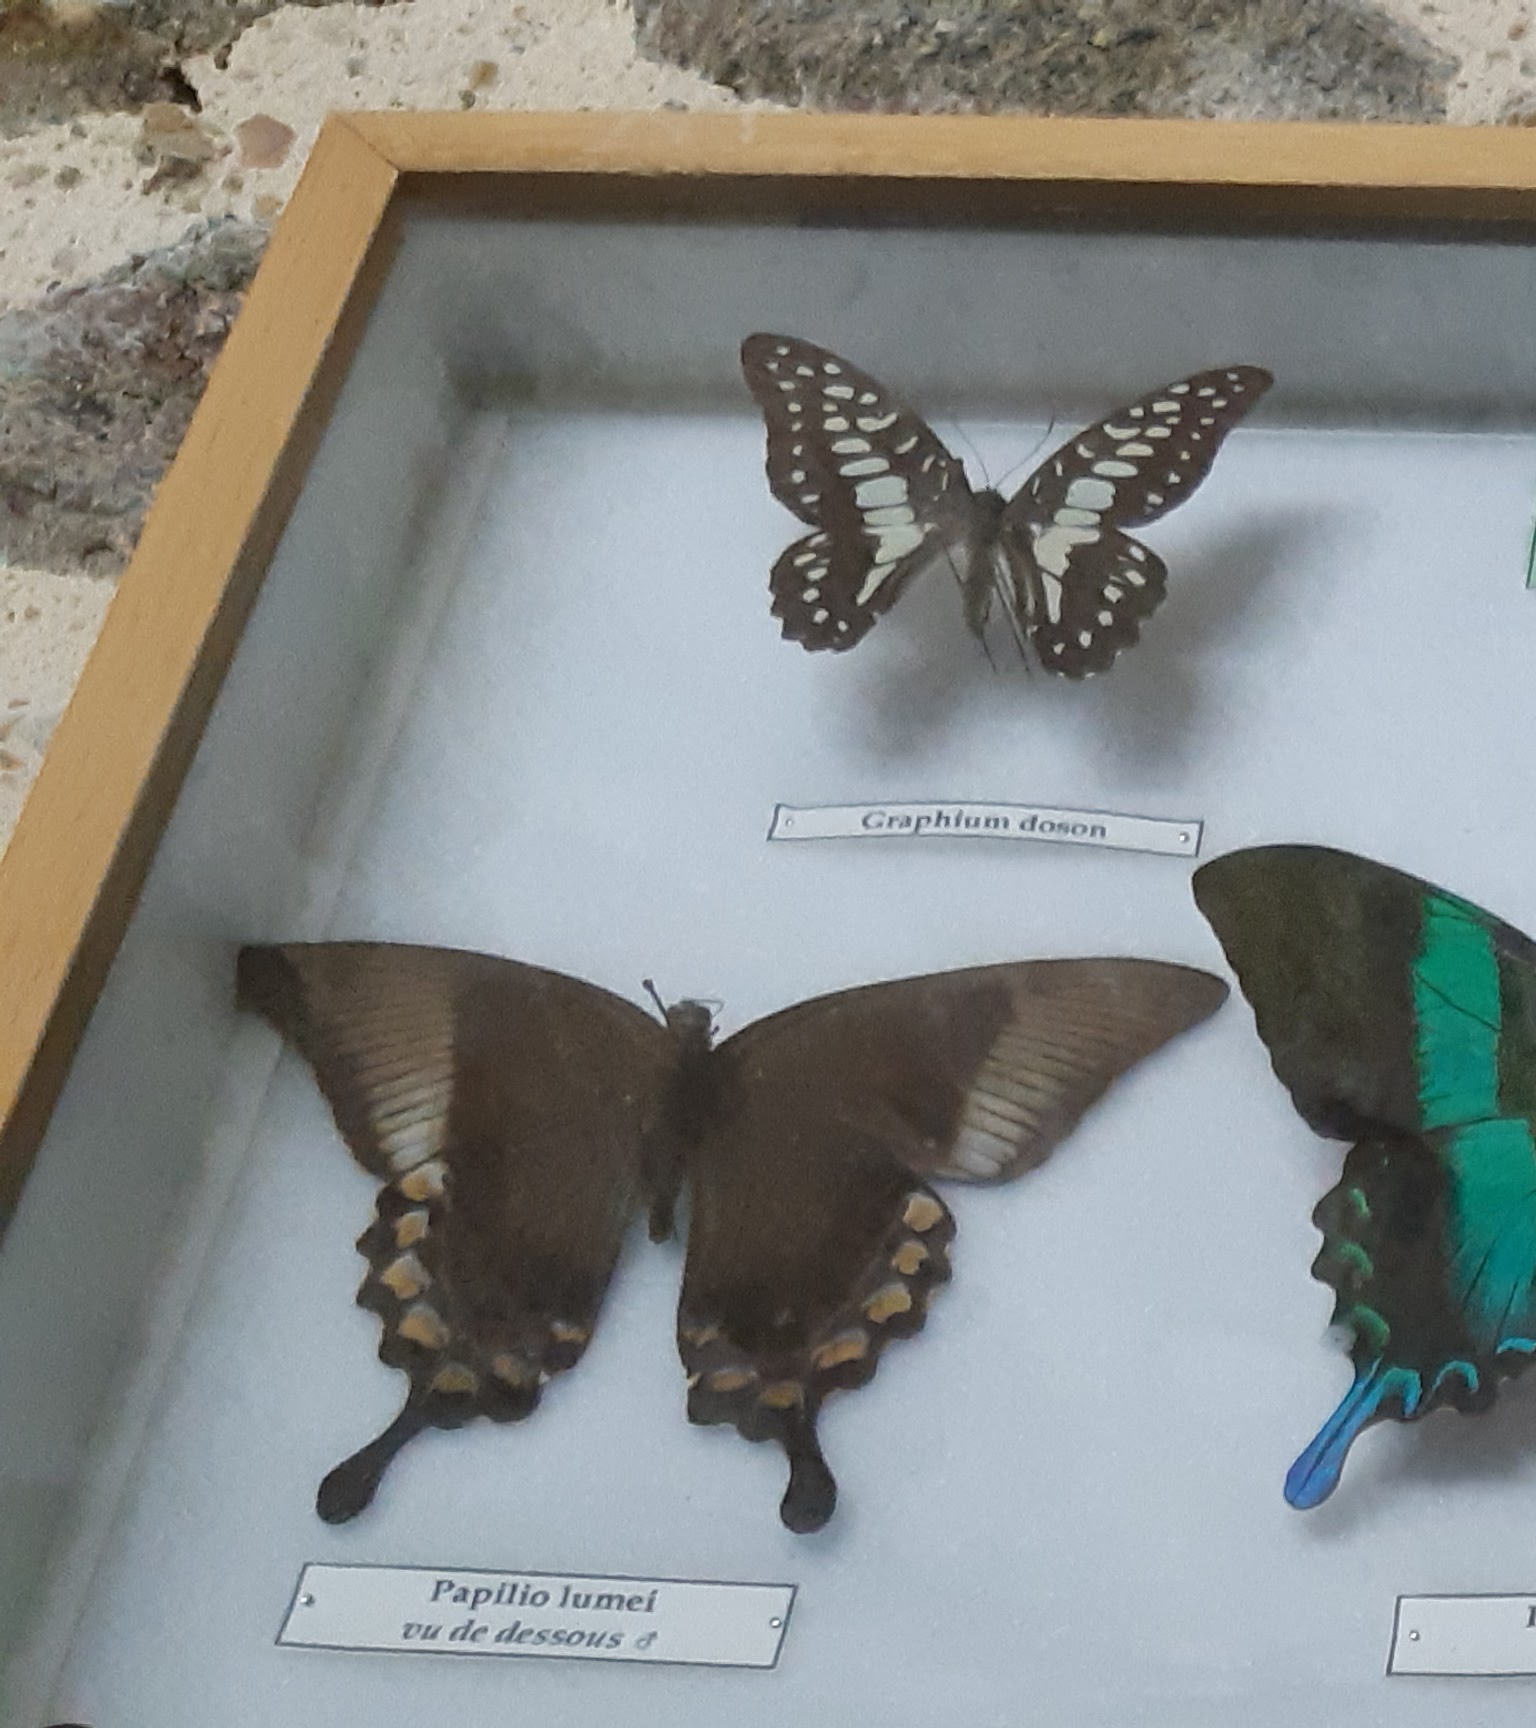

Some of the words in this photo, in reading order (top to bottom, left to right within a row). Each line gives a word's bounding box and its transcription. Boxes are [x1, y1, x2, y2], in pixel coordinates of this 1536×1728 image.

[861, 809, 1009, 834] Graphium
[1018, 814, 1107, 838] doson
[431, 1578, 550, 1611] Papilio
[559, 1584, 658, 1613] lumei
[402, 1623, 441, 1642] vu
[450, 1620, 488, 1644] de
[494, 1623, 623, 1650] dessous
